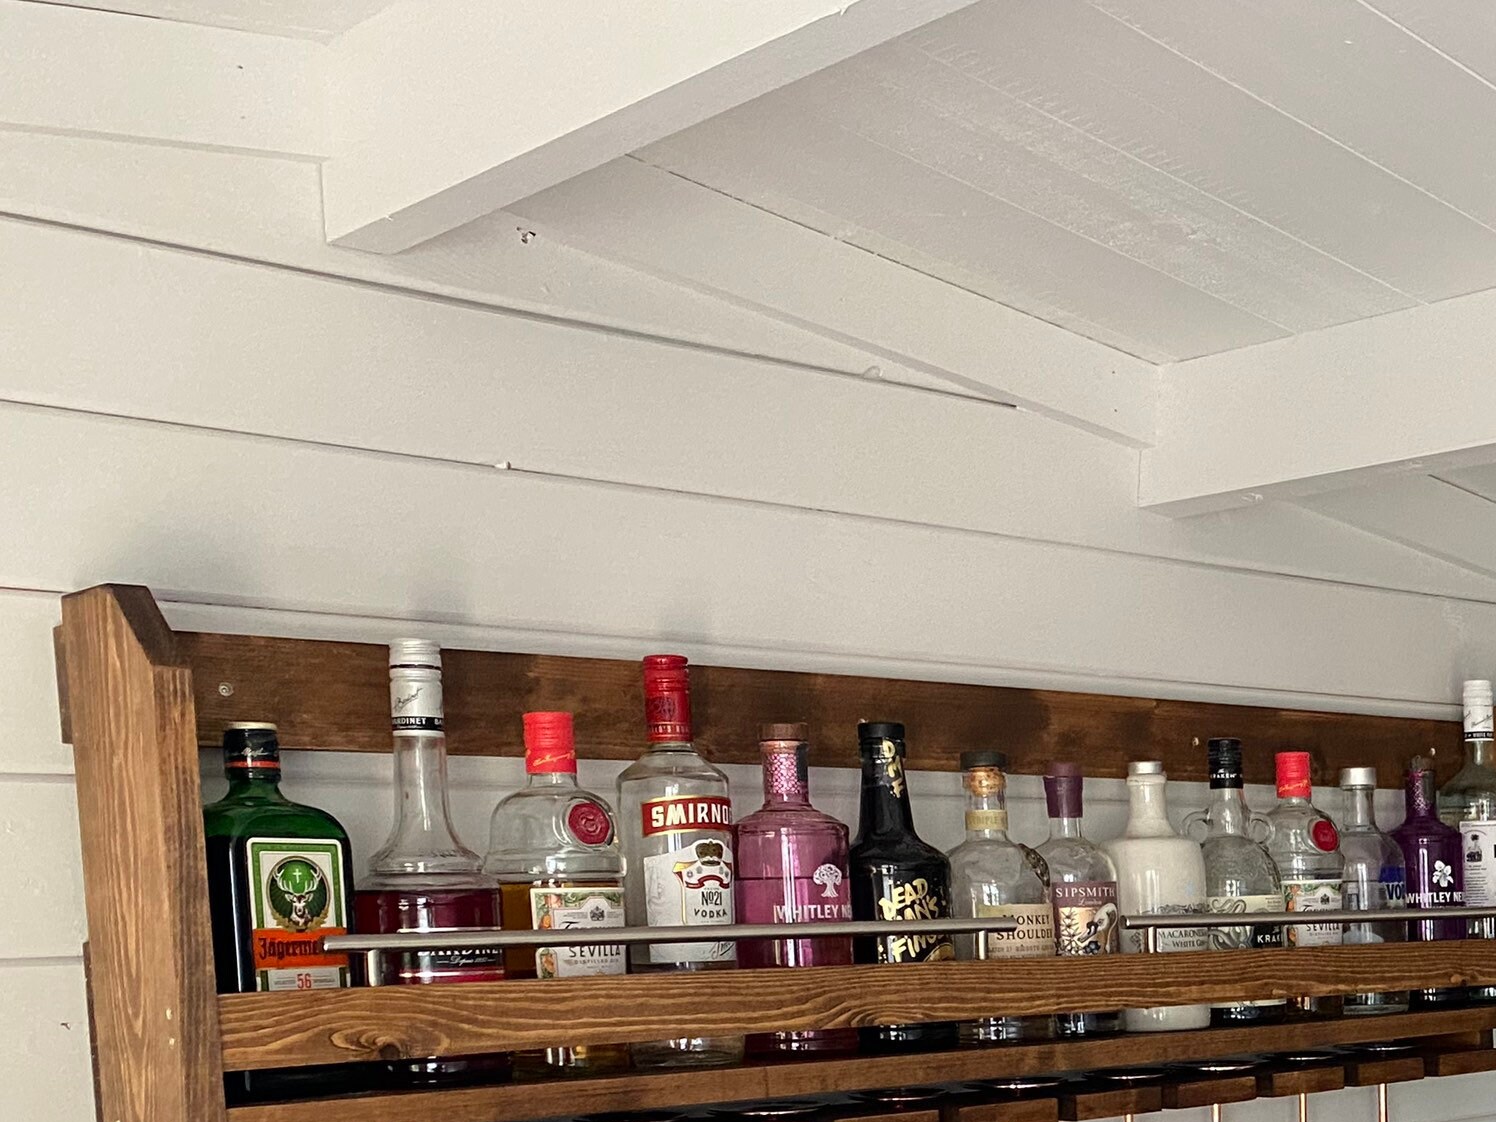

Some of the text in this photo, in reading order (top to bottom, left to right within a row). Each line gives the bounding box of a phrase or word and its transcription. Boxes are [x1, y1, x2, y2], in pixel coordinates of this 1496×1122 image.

[651, 803, 730, 829] SMIRNO
[879, 878, 929, 921] DEAD
[1056, 888, 1115, 898] SIPSMITH
[694, 908, 729, 919] VODKA
[1003, 914, 1051, 926] ONKEY
[568, 944, 621, 958] SEVILLA
[296, 973, 312, 989] 56
